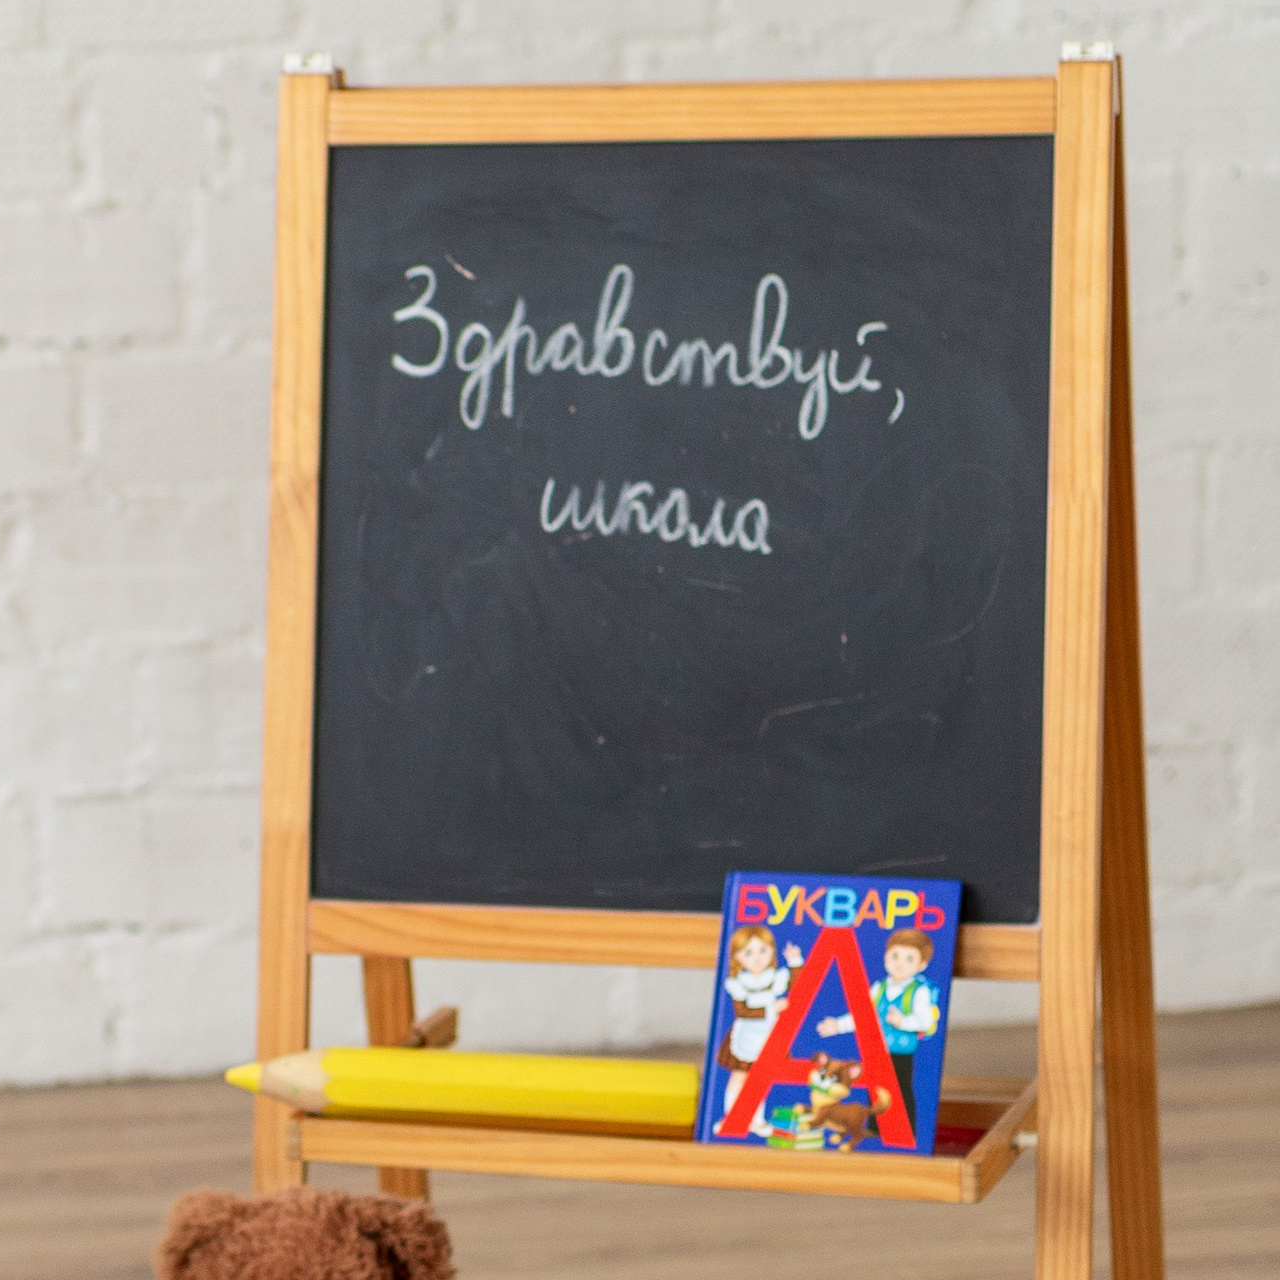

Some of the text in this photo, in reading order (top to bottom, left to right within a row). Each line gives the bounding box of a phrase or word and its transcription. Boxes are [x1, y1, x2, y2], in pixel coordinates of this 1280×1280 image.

[391, 263, 906, 440] Здравствуй,
[539, 476, 773, 554] школа
[735, 883, 947, 932] БУКВАРЬ
